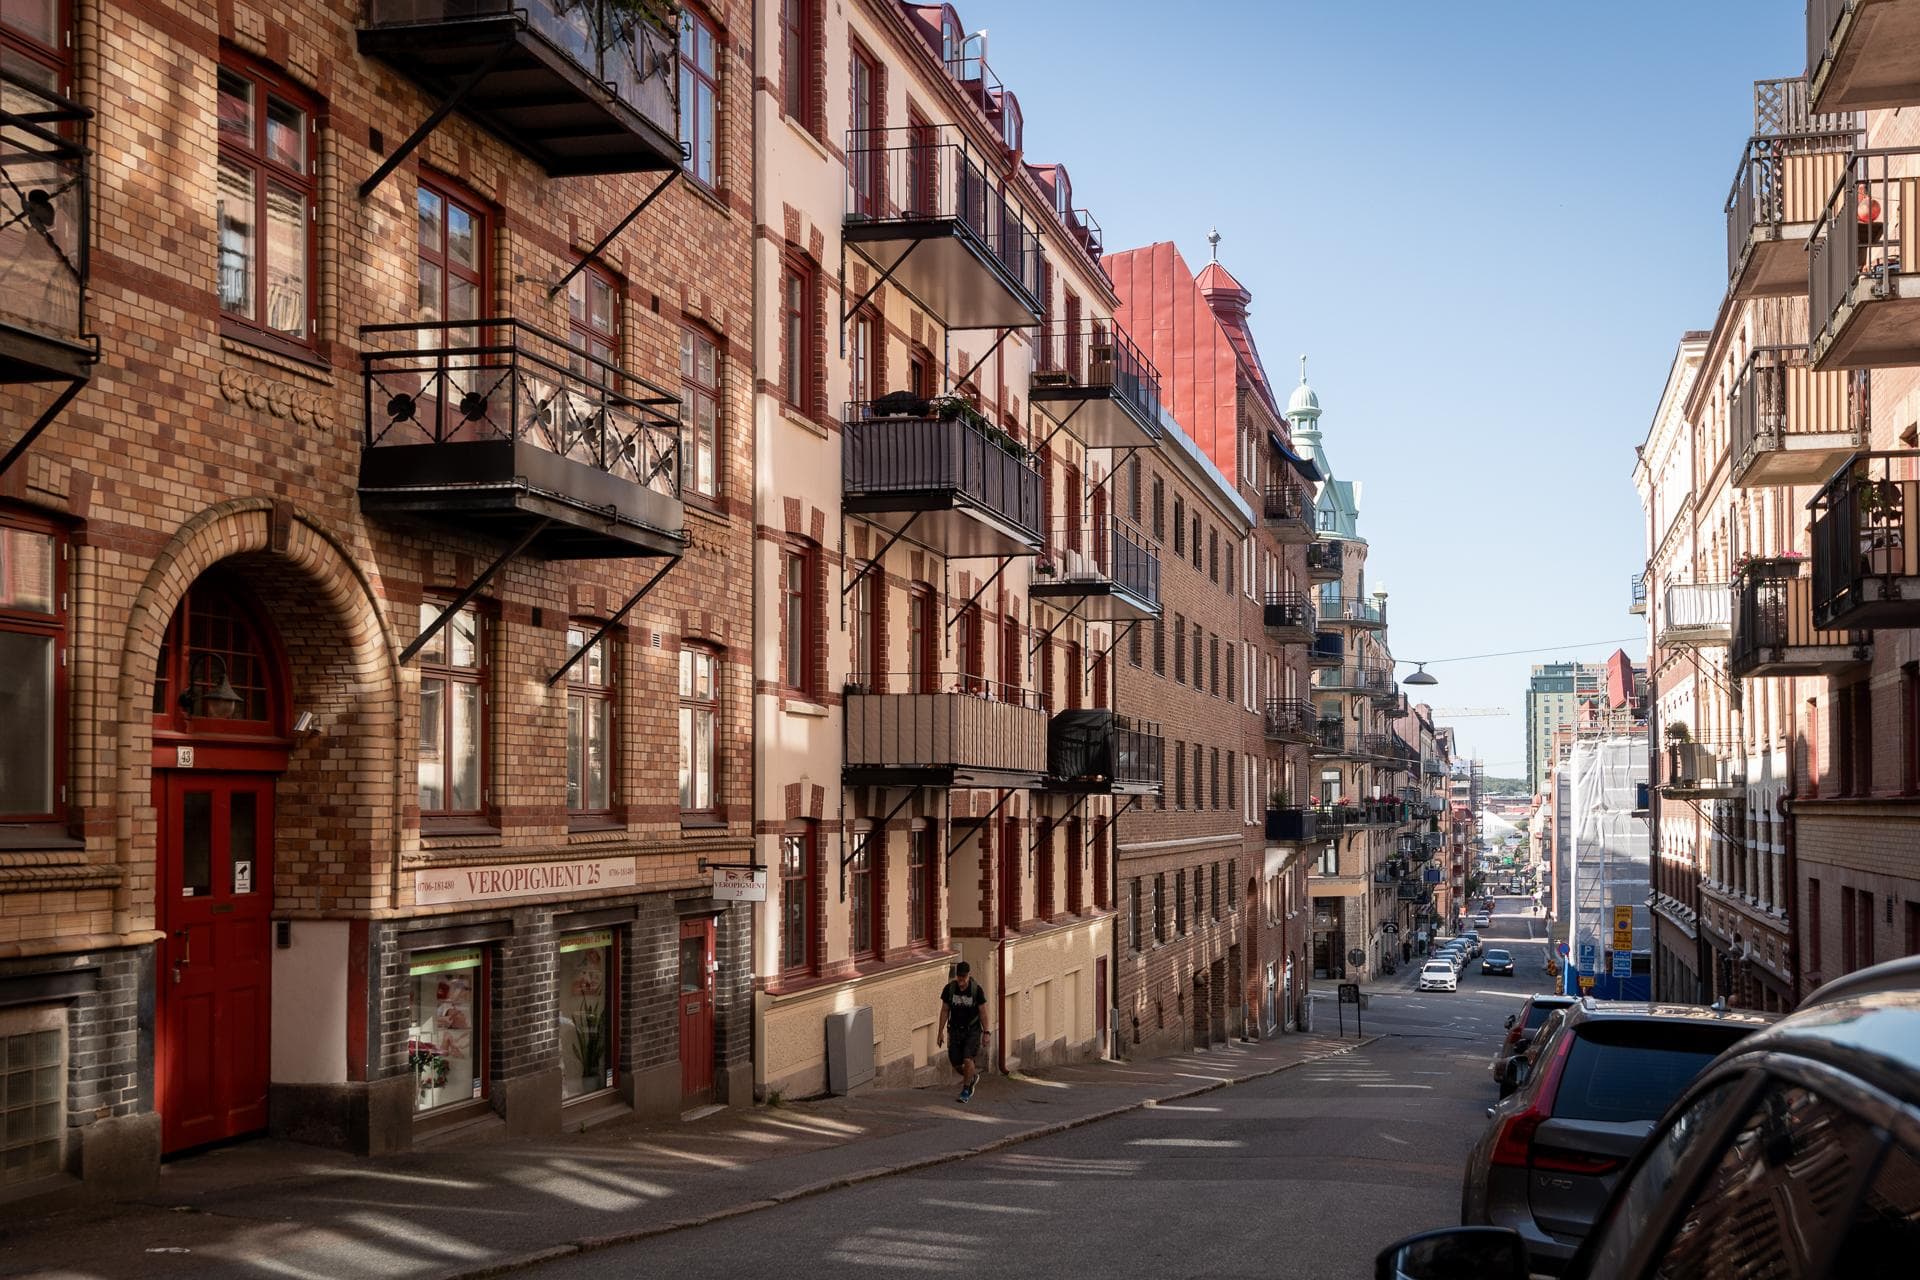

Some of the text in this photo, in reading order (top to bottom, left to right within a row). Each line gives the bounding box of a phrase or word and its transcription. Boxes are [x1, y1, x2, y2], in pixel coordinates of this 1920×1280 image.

[181, 750, 191, 763] 43
[467, 864, 583, 894] VEROPIGMENT
[587, 863, 601, 885] 25
[714, 881, 766, 889] VEROPIGMENT
[1584, 945, 1592, 956] P
